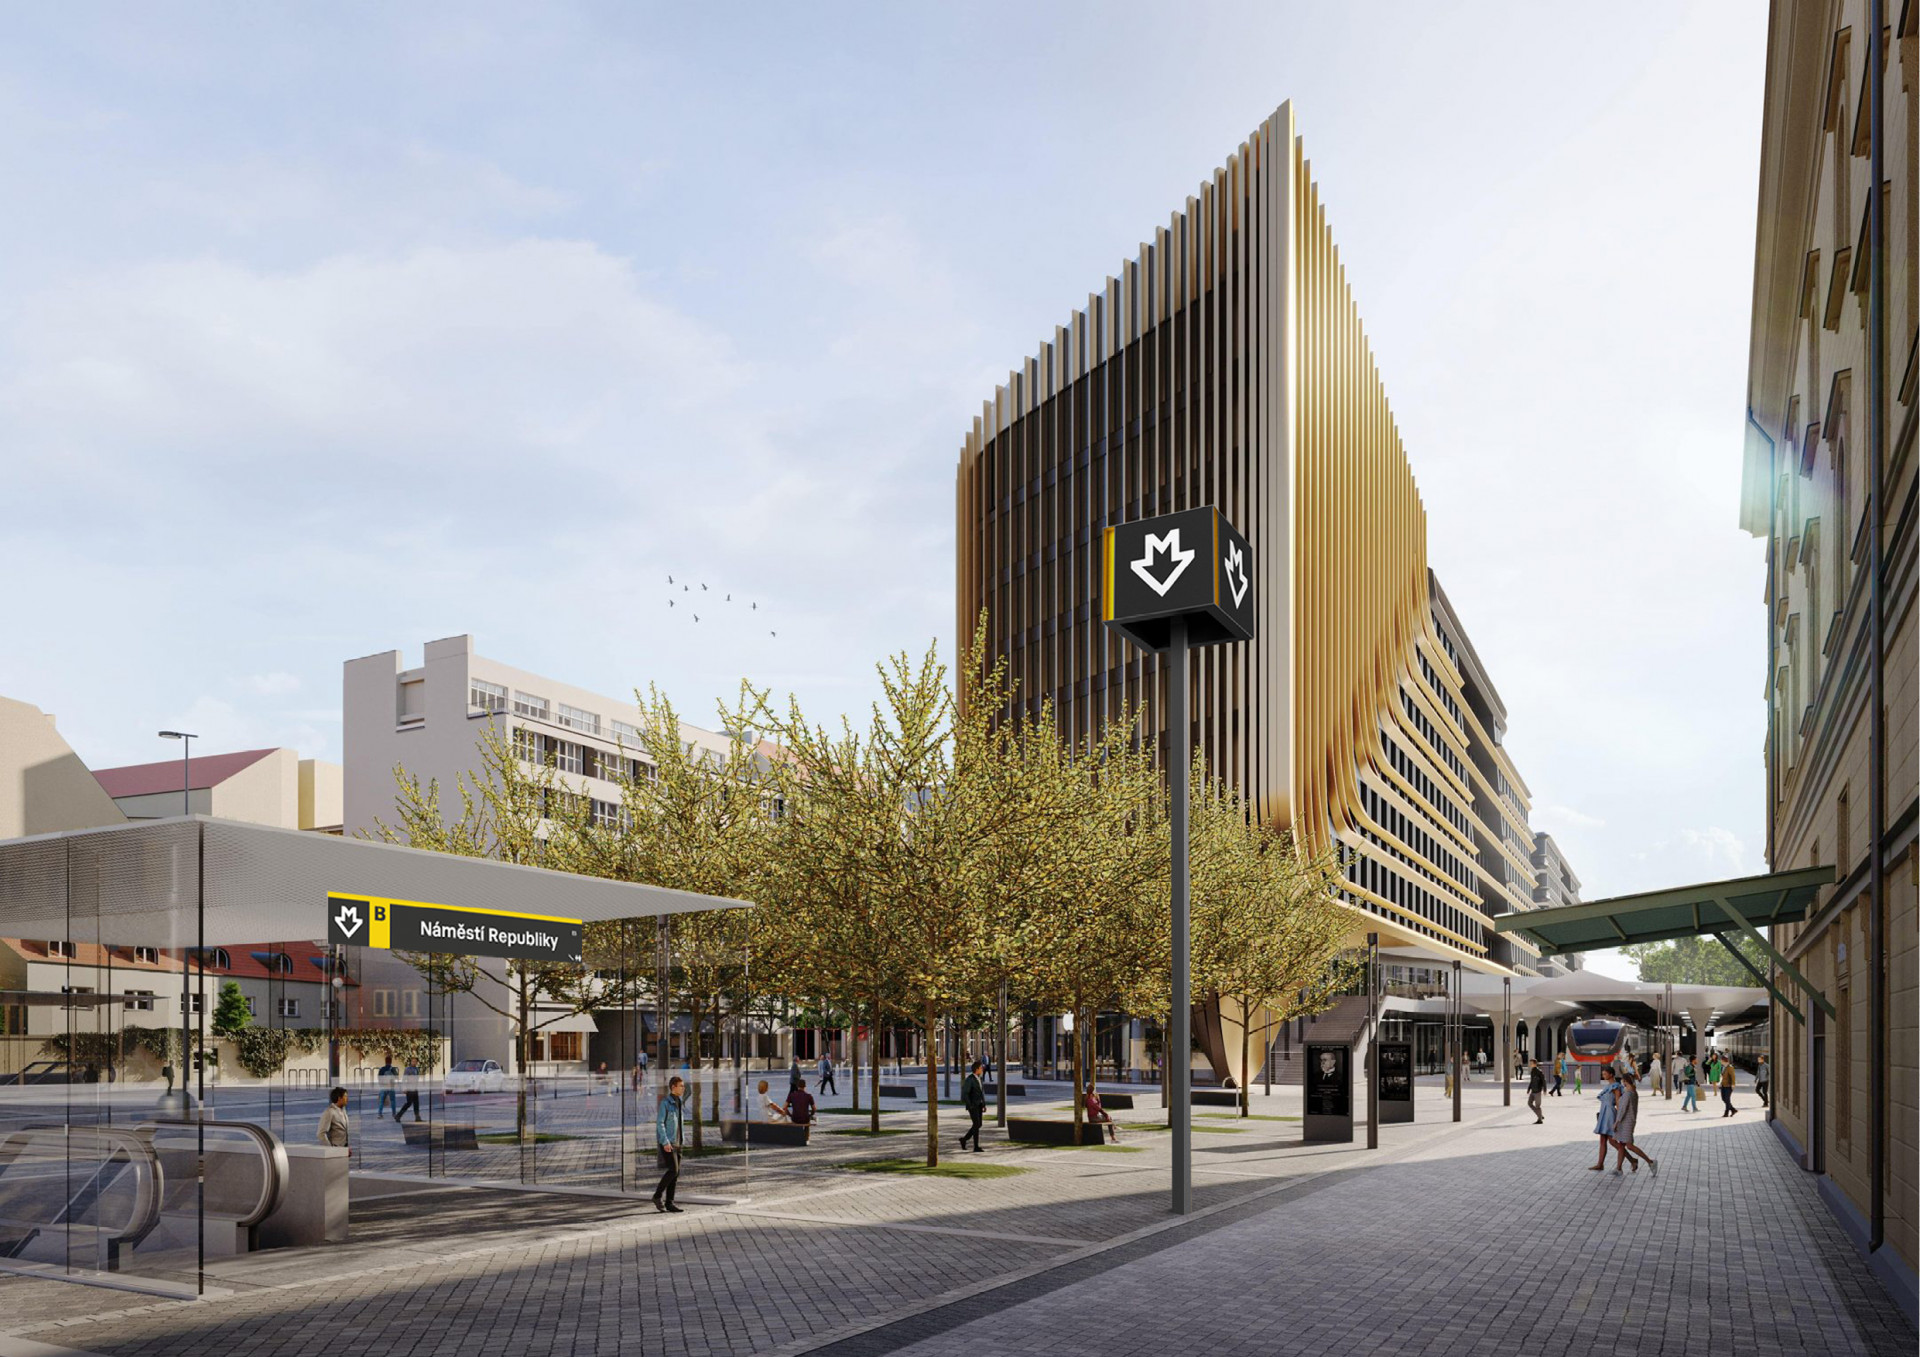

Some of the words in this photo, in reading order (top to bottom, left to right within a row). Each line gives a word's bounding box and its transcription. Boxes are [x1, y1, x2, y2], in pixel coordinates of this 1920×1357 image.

[374, 906, 386, 921] B
[420, 920, 485, 942] Náměstí
[488, 930, 559, 951] Republiky
